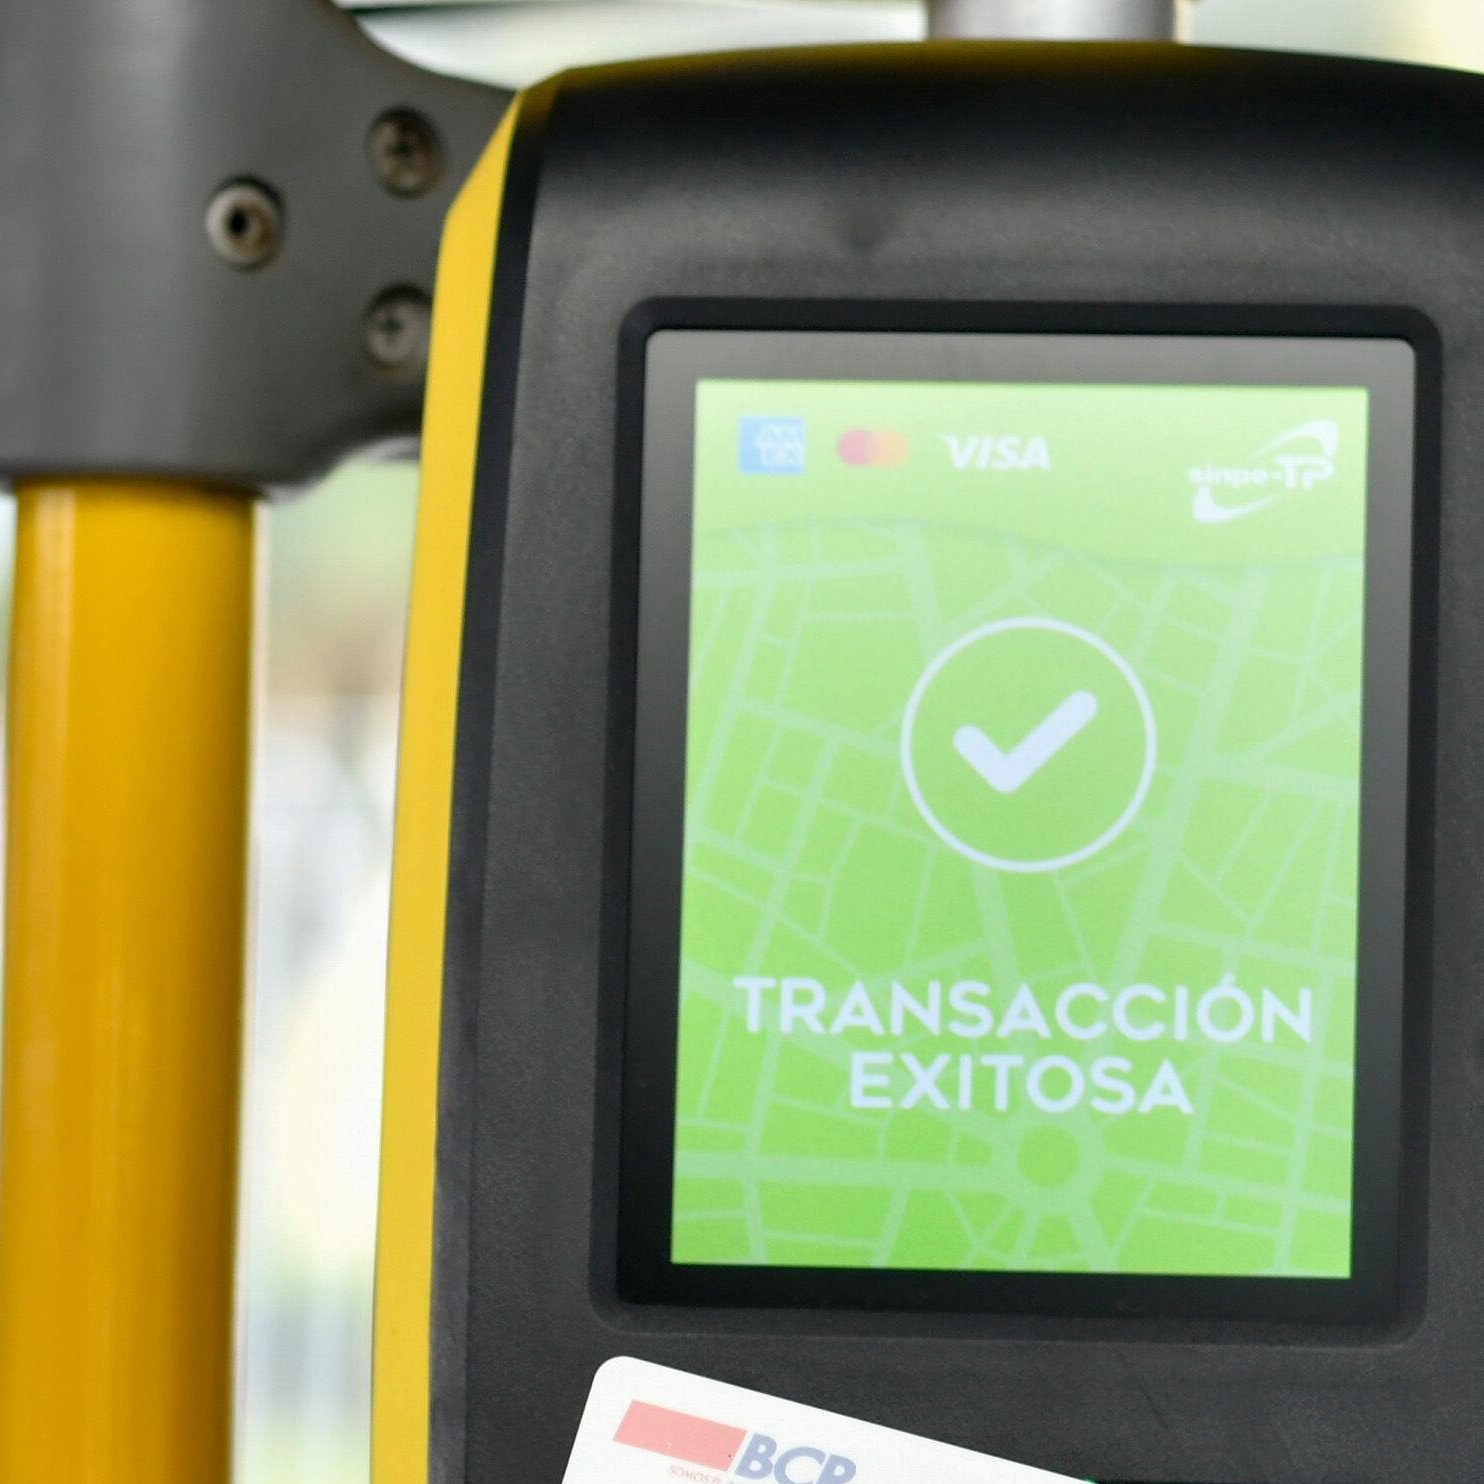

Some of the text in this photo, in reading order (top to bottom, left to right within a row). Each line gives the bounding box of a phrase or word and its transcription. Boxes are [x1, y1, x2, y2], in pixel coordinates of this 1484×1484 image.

[941, 433, 1053, 470] VISA
[733, 972, 1314, 1044] TRANSACCIÓN
[848, 1052, 1195, 1115] EXITOSA
[667, 1464, 709, 1483] SOMOS
